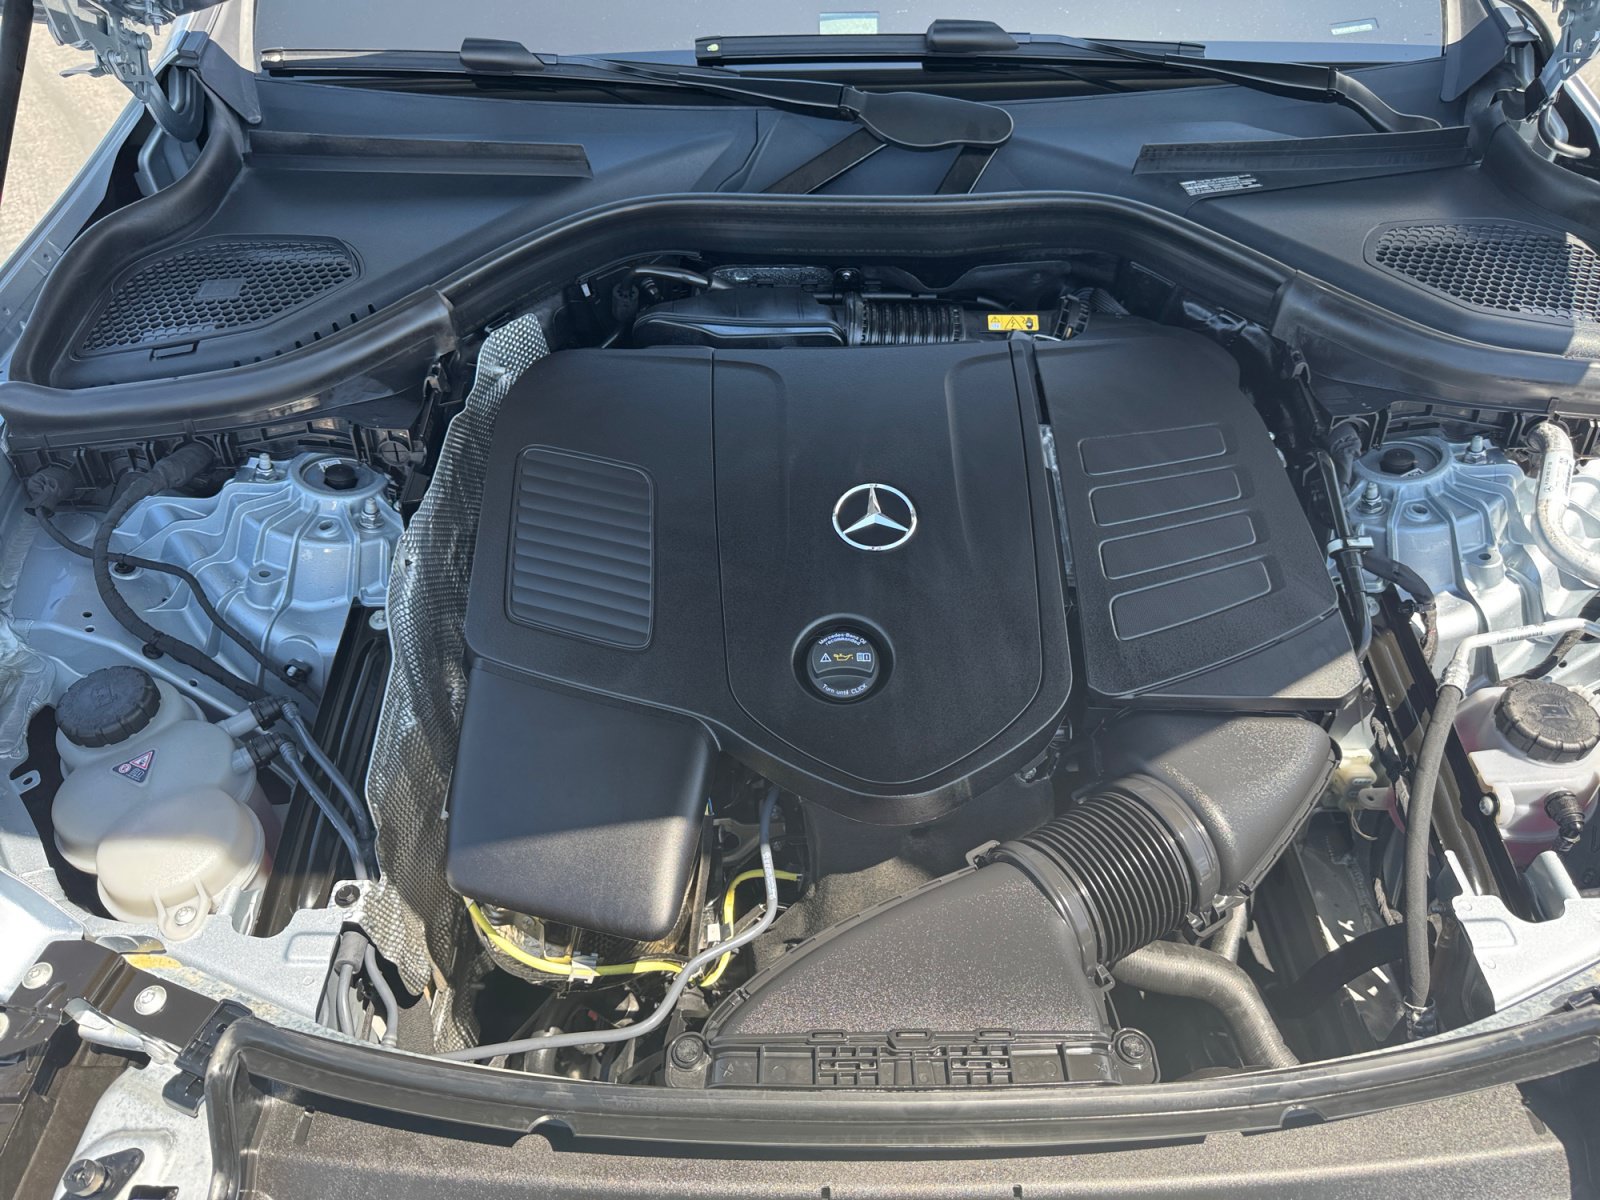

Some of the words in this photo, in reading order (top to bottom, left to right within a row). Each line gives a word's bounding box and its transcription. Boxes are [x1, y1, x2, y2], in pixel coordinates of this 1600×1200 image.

[825, 637, 861, 646] recommended
[822, 683, 835, 693] Turn
[850, 683, 868, 695] CLICK
